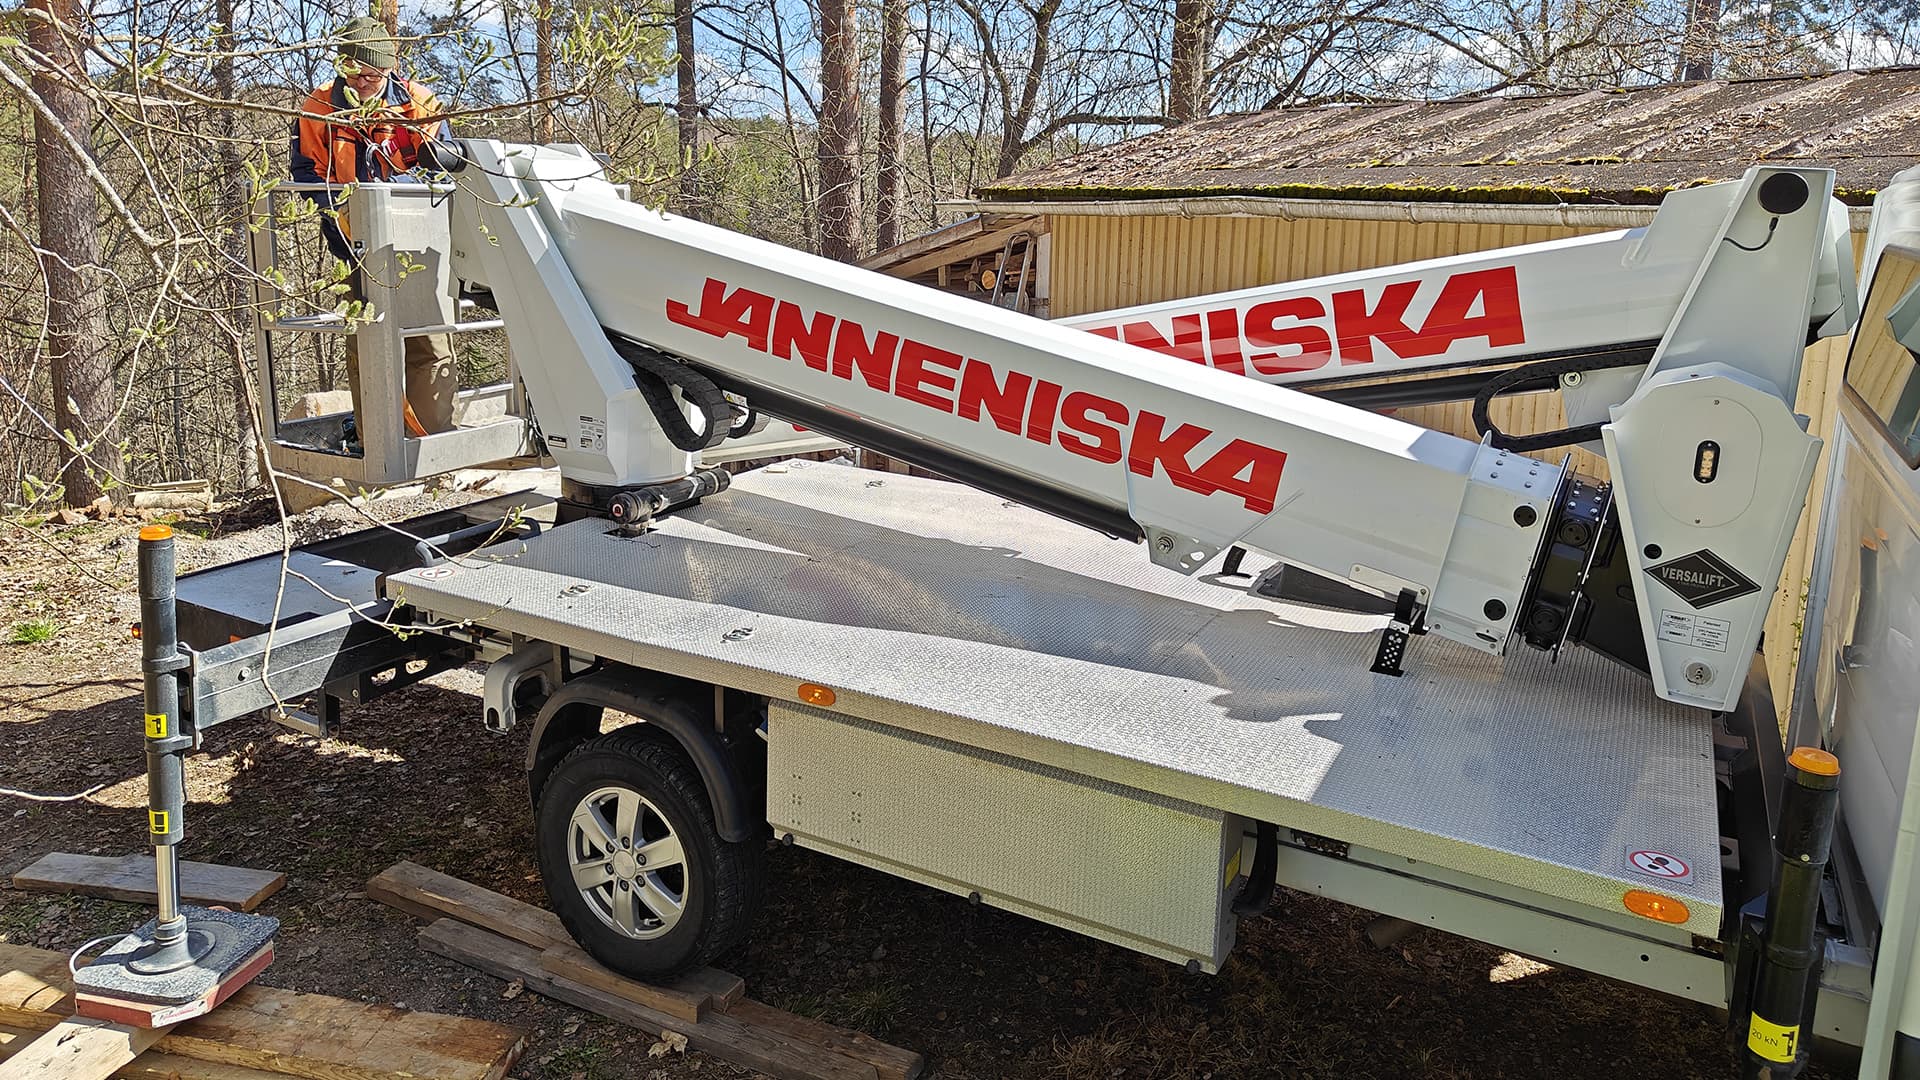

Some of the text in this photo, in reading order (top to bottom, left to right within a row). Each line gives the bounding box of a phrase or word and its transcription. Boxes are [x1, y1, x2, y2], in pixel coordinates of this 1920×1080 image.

[666, 277, 1288, 515] JANNENISKA
[1661, 566, 1724, 587] VERSALIFT
[1752, 1028, 1778, 1047] 20 kN
